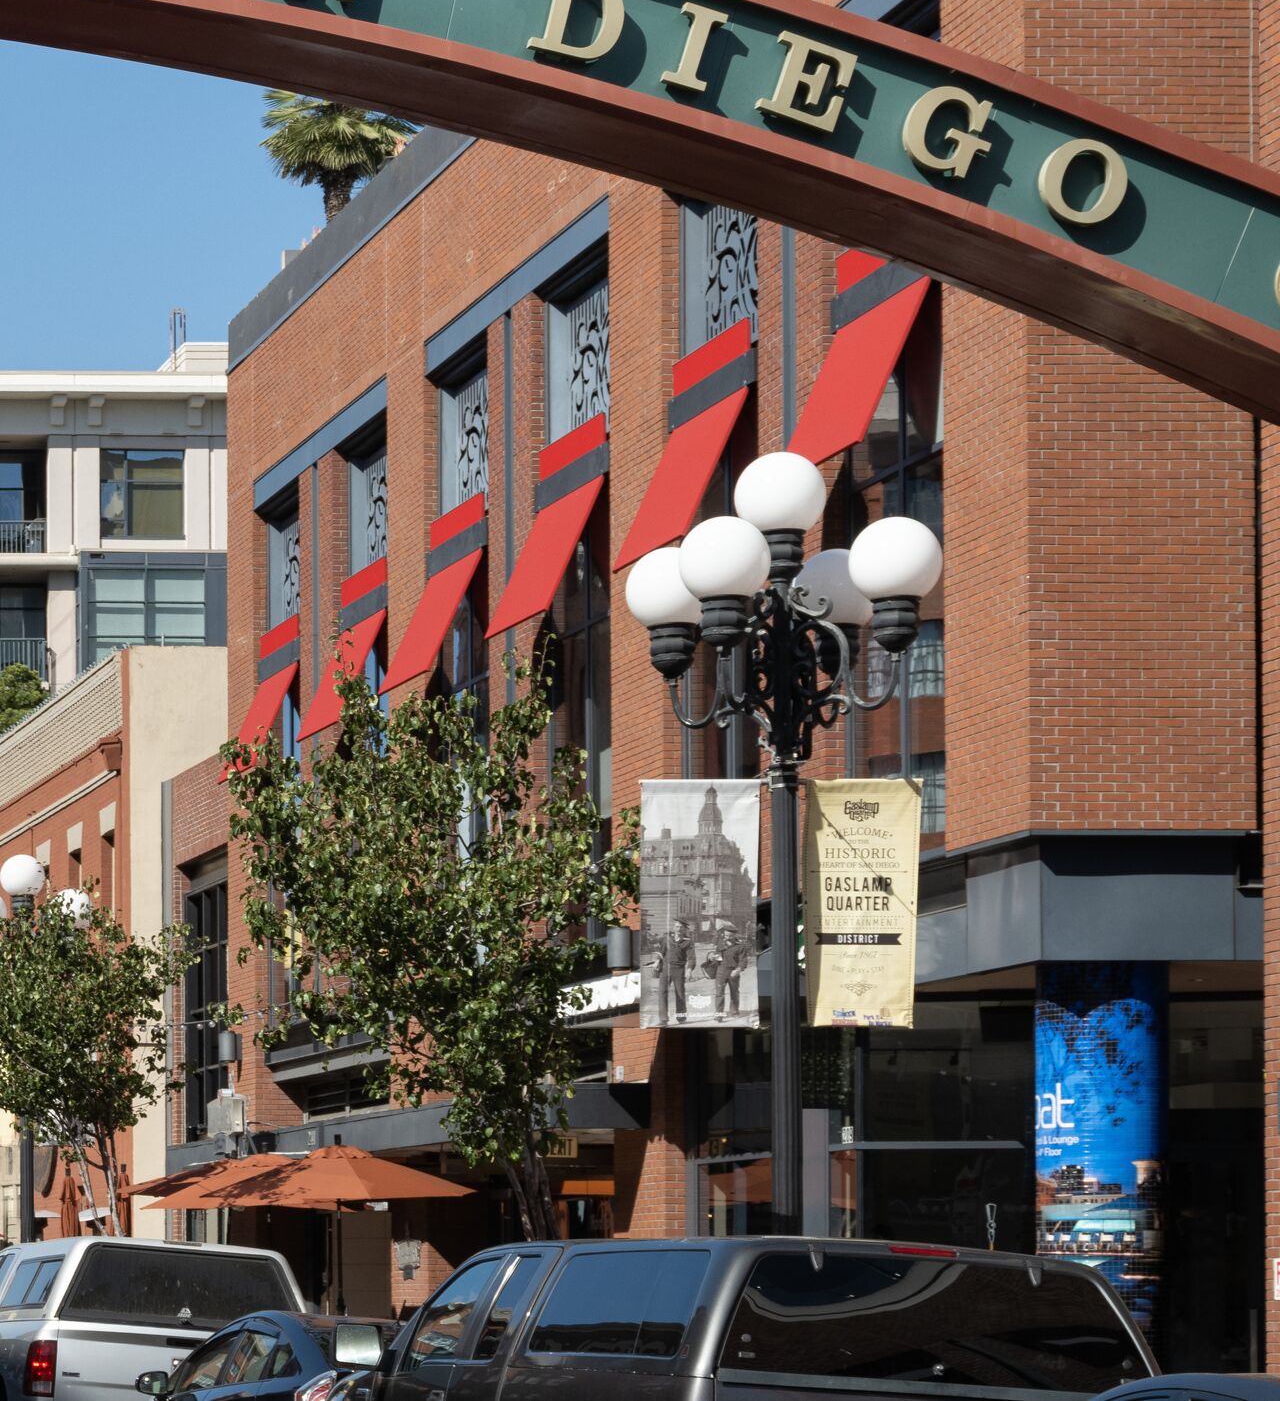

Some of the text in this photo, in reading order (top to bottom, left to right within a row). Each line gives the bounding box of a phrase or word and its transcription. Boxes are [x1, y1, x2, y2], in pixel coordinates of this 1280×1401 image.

[824, 847, 897, 859] HISTORIC
[846, 861, 857, 869] OF
[858, 861, 874, 869] SAN
[875, 861, 901, 869] DIEGO
[825, 877, 892, 892] GASLAMP
[826, 896, 890, 911] QUARTER
[837, 934, 880, 944] DISTRICT
[1049, 1136, 1080, 1146] Lounge
[1044, 1148, 1062, 1156] Floor
